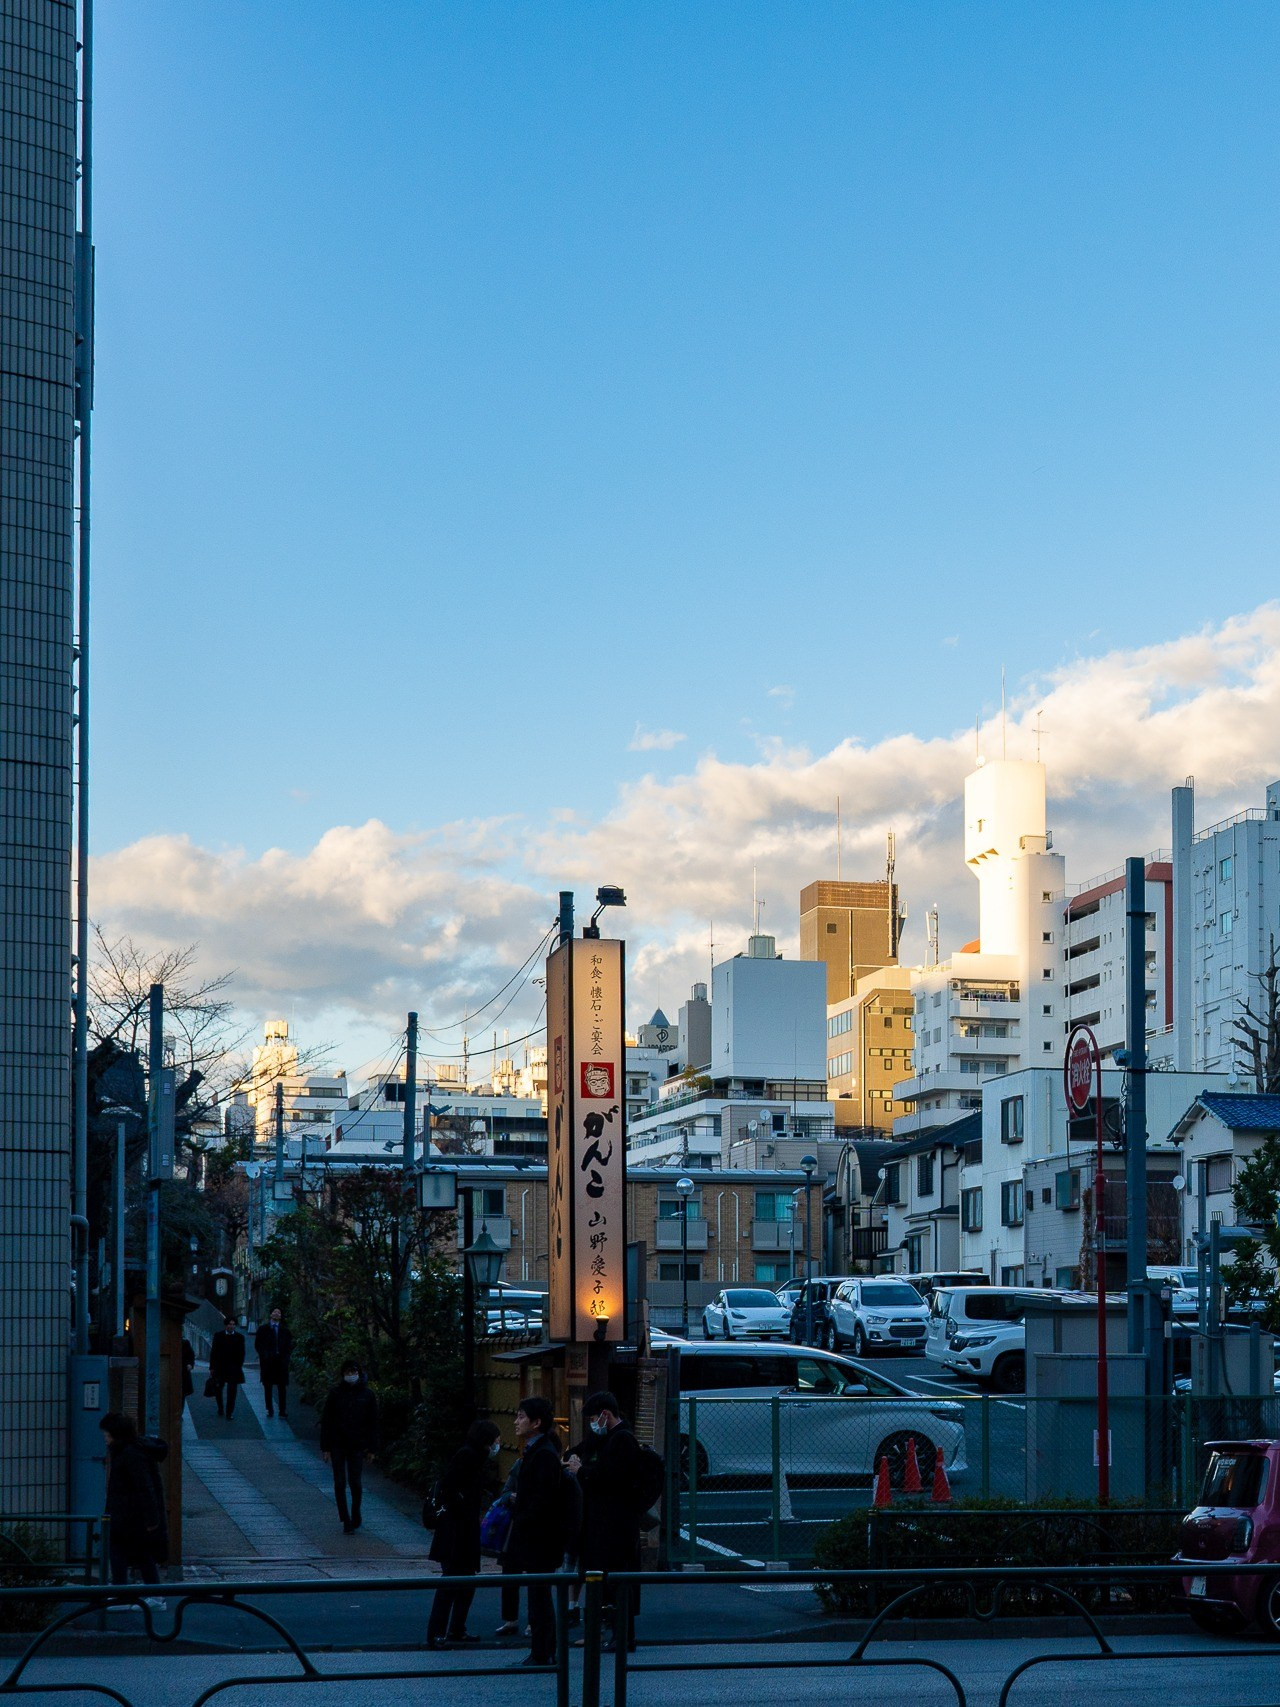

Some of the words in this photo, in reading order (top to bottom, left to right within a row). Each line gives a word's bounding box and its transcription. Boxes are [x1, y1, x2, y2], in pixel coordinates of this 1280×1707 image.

[590, 955, 605, 1056] 和食・懐石・ご宴会
[1072, 1058, 1091, 1088] 消火栓
[580, 1104, 620, 1199] がんこ
[589, 1211, 608, 1316] 山野愛子邸
